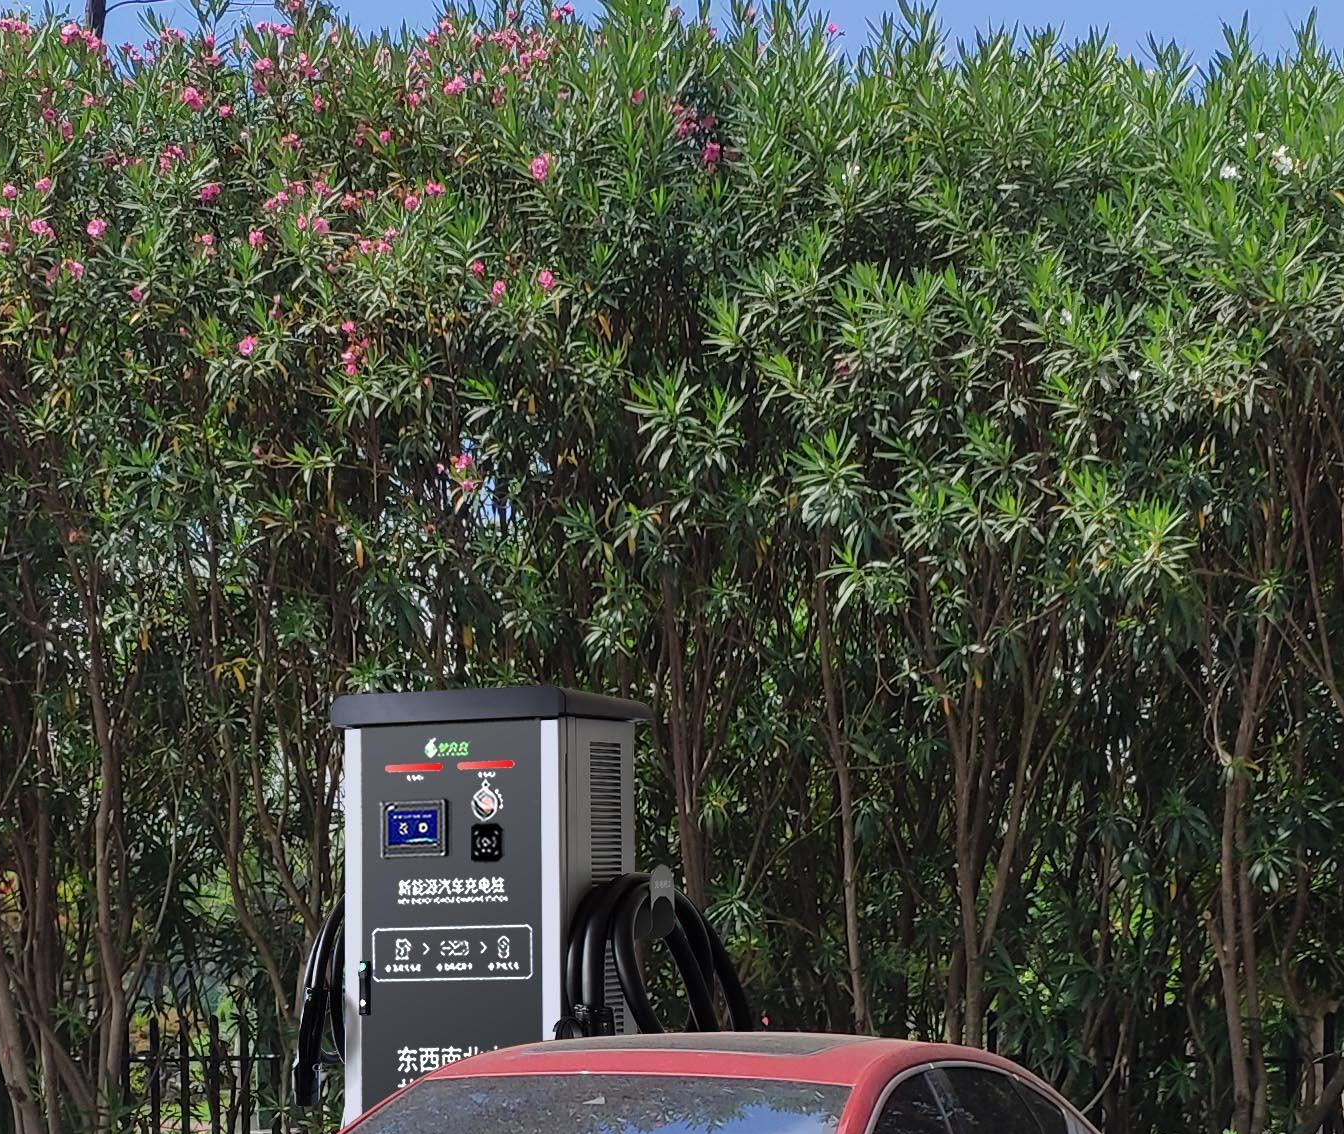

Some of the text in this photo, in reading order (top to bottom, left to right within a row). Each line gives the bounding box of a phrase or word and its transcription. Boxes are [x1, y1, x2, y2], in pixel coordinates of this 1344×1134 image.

[398, 877, 505, 896] 新能源汽车充电桩
[397, 1046, 499, 1073] 东西南
